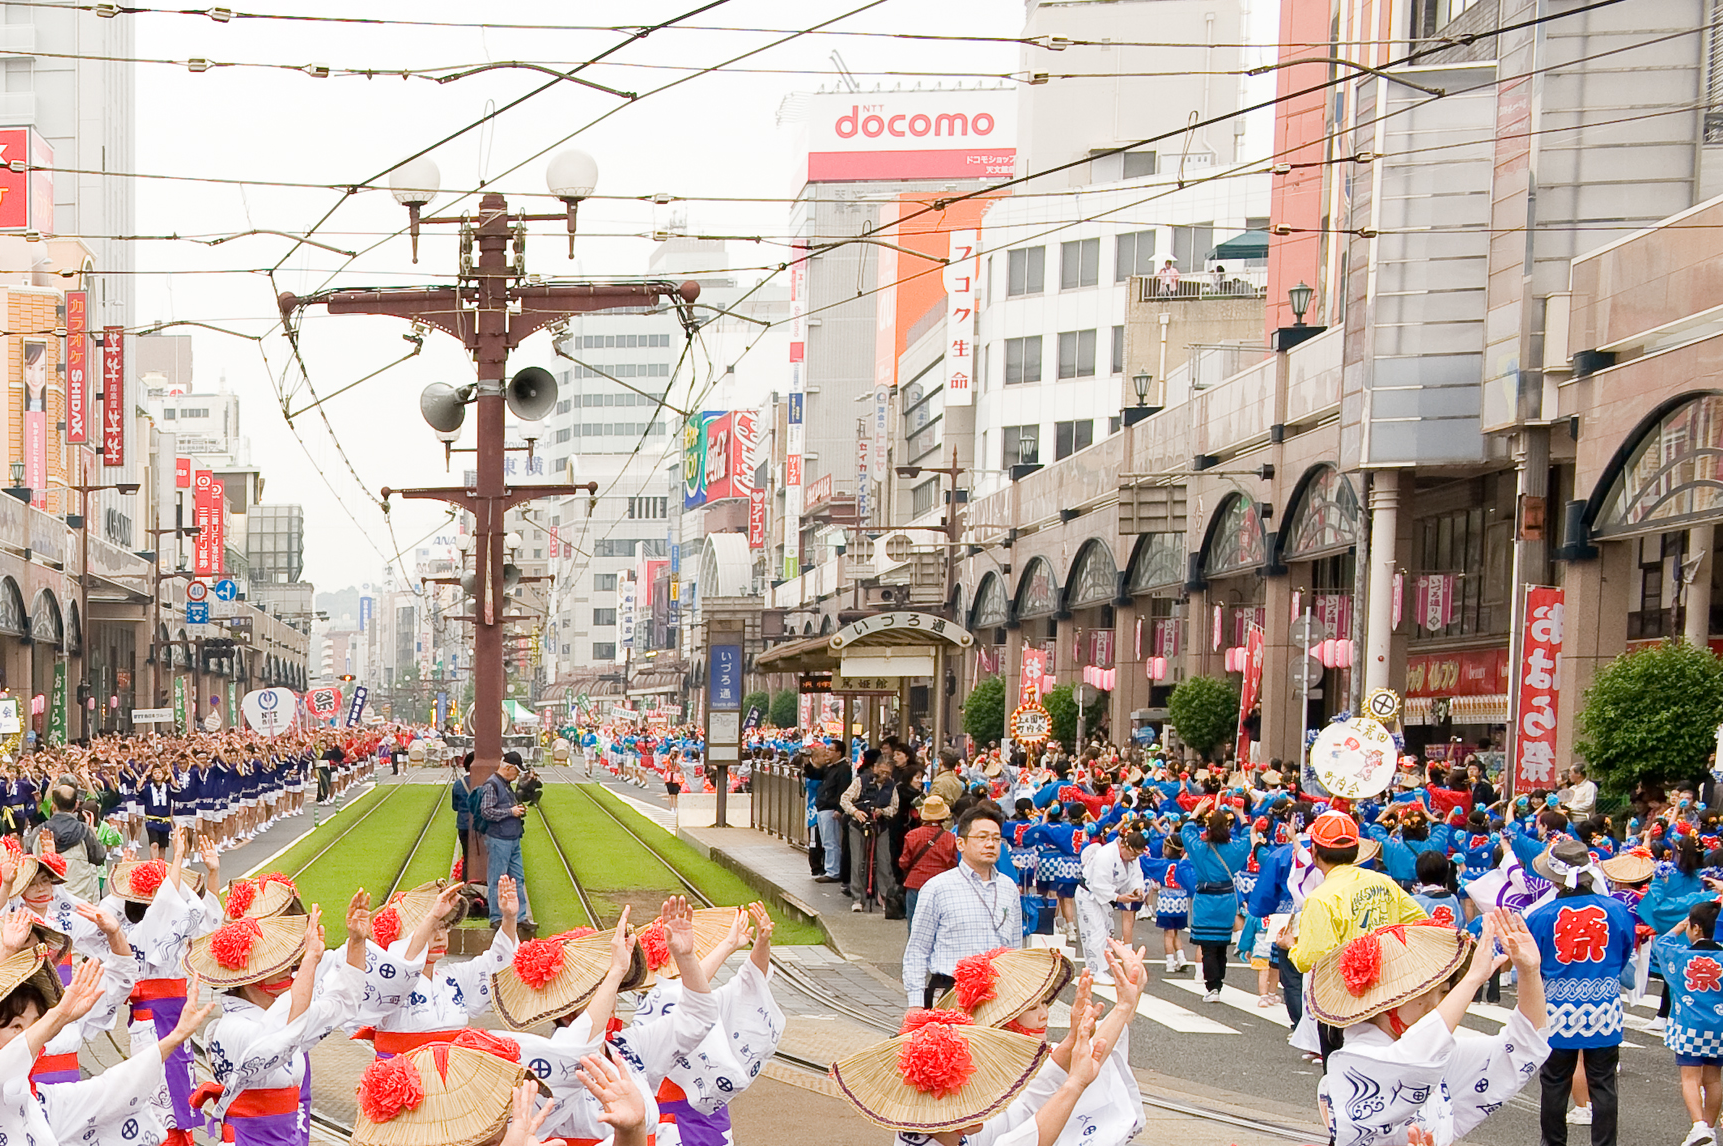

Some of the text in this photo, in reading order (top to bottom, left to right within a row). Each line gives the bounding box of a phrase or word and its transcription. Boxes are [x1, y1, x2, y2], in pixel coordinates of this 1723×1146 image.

[835, 105, 995, 139] docomo
[950, 245, 973, 389] フコク生命
[69, 298, 84, 436] カラオケ SHIDAX
[751, 503, 763, 544] アイフル
[190, 586, 203, 597] 40
[853, 613, 947, 635] いづろ通
[719, 651, 733, 699] いづろ通
[1520, 602, 1564, 783] おはら祭
[1553, 904, 1610, 966] 祭
[1682, 954, 1723, 993] 祭
